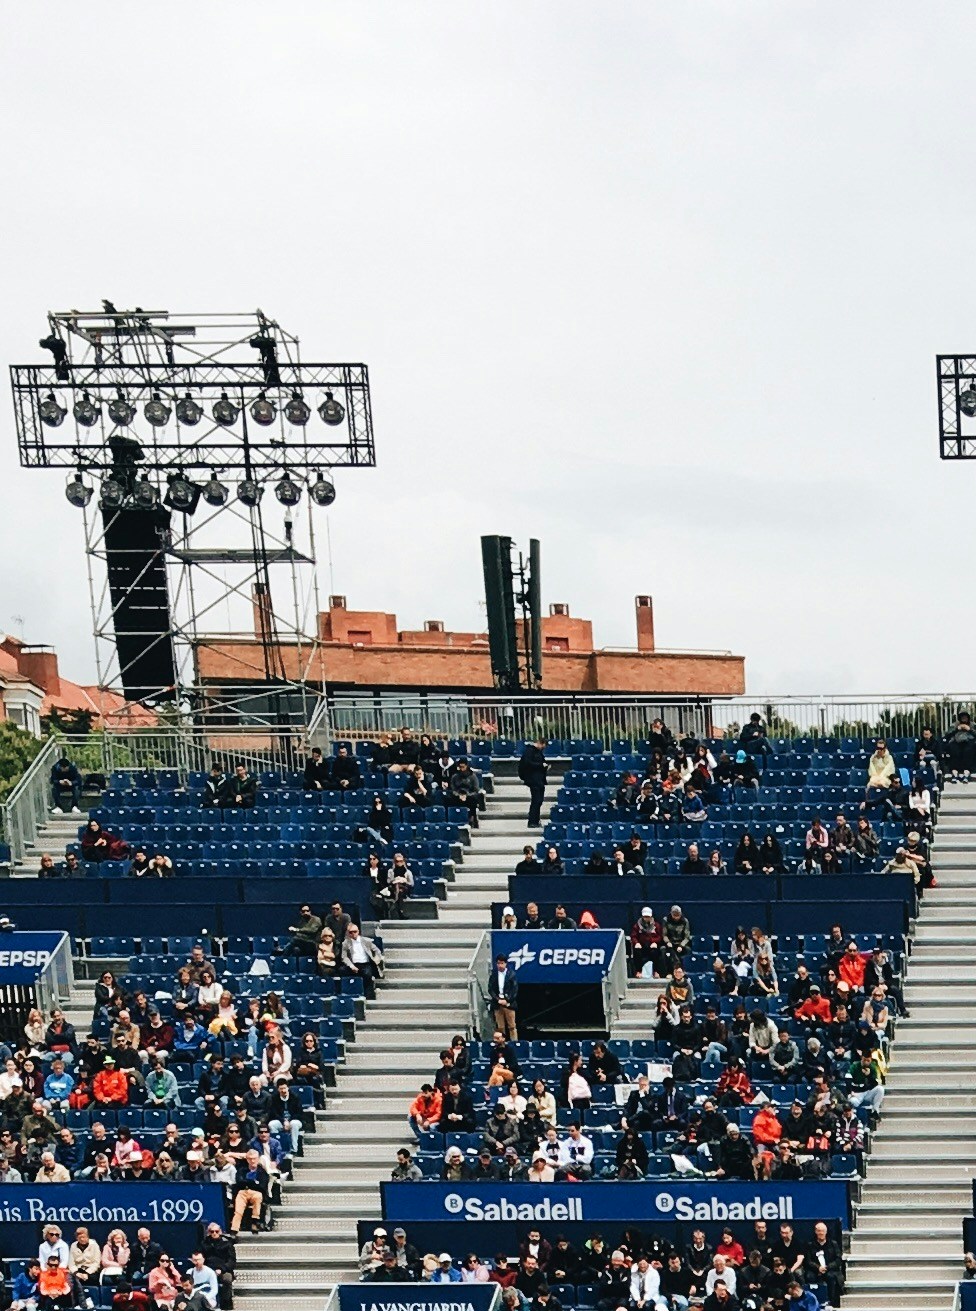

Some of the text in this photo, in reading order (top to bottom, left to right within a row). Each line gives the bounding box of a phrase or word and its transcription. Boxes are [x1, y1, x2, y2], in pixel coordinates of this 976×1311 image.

[538, 948, 606, 966] CEPSA
[464, 1197, 583, 1220] Sabadell
[675, 1196, 794, 1220] Sabadell
